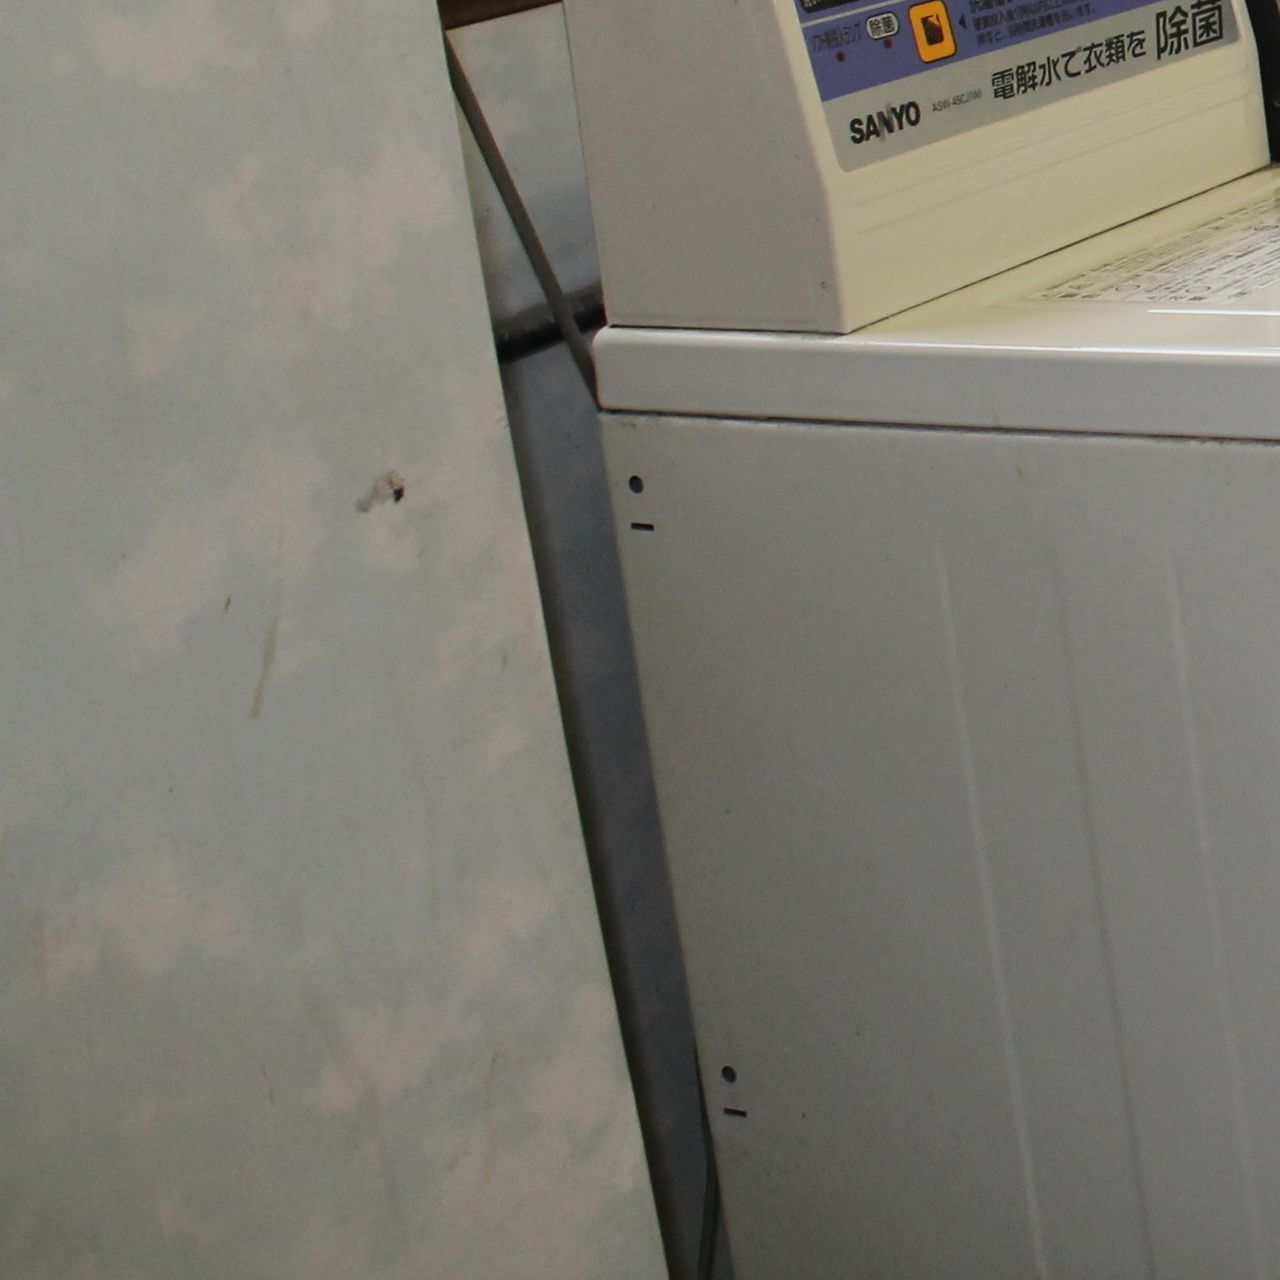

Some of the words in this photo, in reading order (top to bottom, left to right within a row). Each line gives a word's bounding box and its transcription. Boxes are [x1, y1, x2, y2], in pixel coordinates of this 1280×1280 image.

[991, 29, 1147, 101] 電解水で衣類を
[849, 101, 921, 145] SANYO
